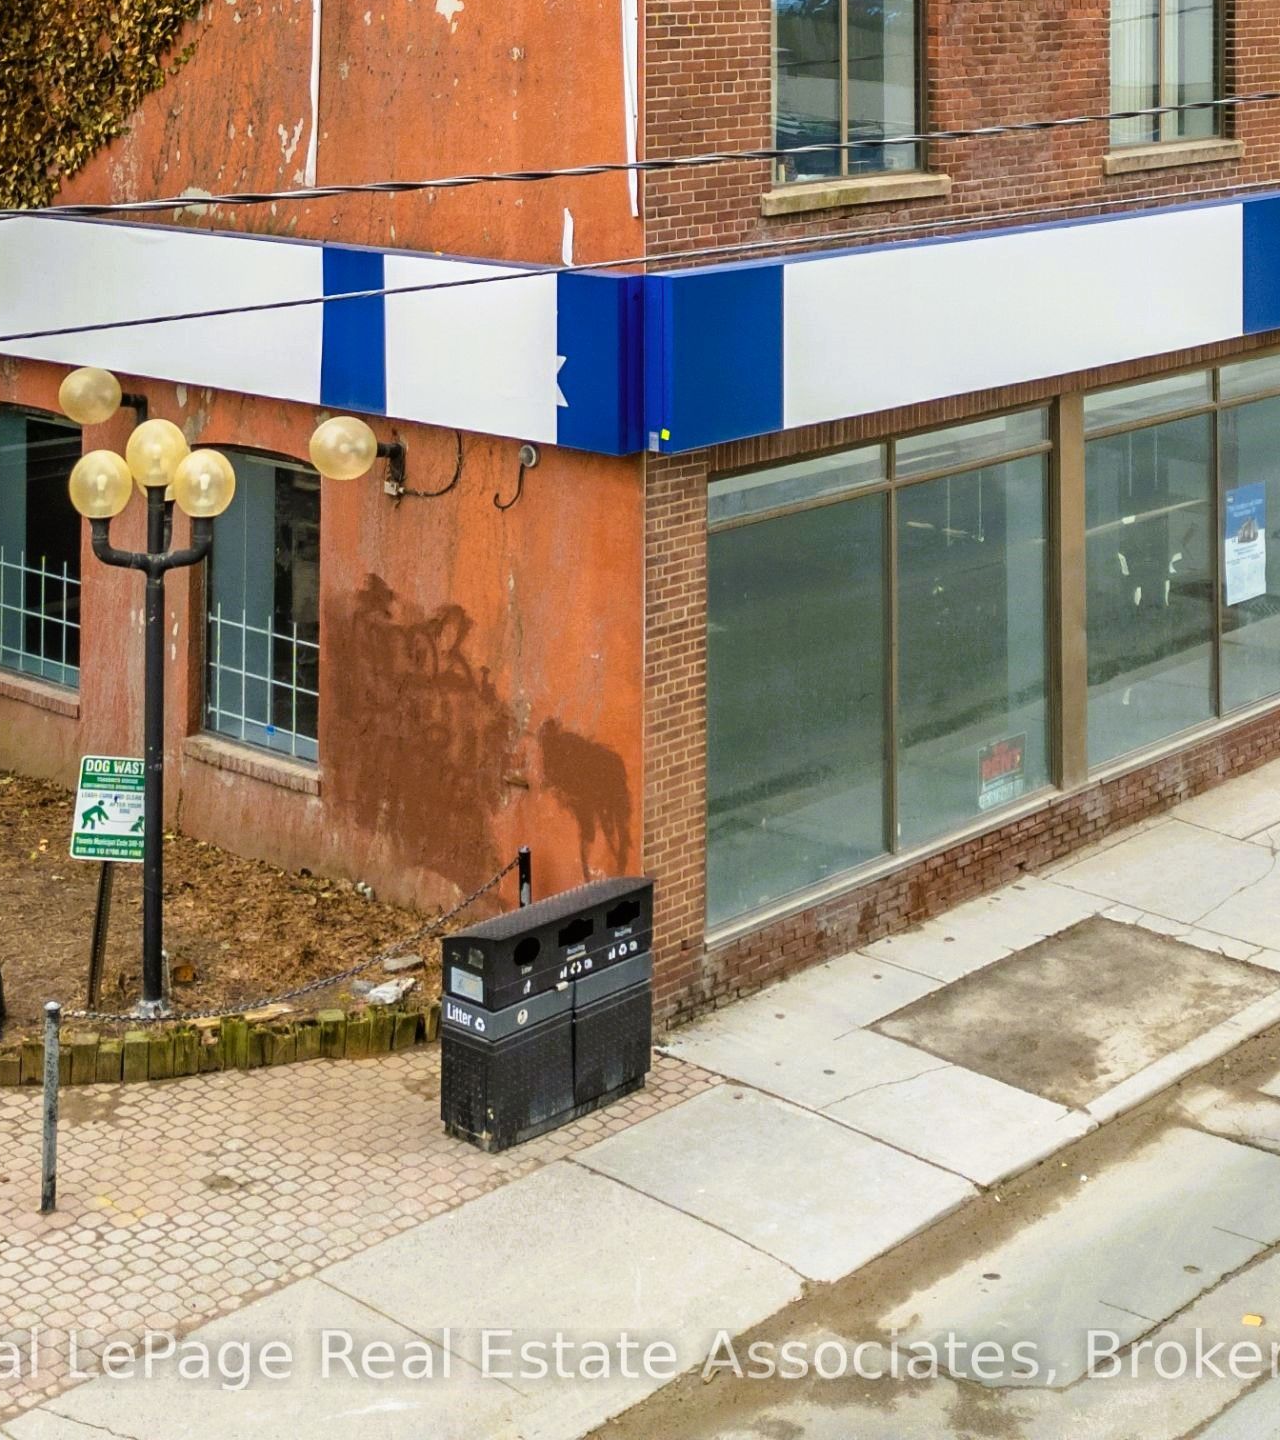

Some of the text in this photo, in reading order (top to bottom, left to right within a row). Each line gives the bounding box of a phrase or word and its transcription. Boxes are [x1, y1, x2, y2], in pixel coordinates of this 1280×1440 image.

[85, 760, 144, 775] DOG WAST
[447, 1003, 472, 1026] Litter
